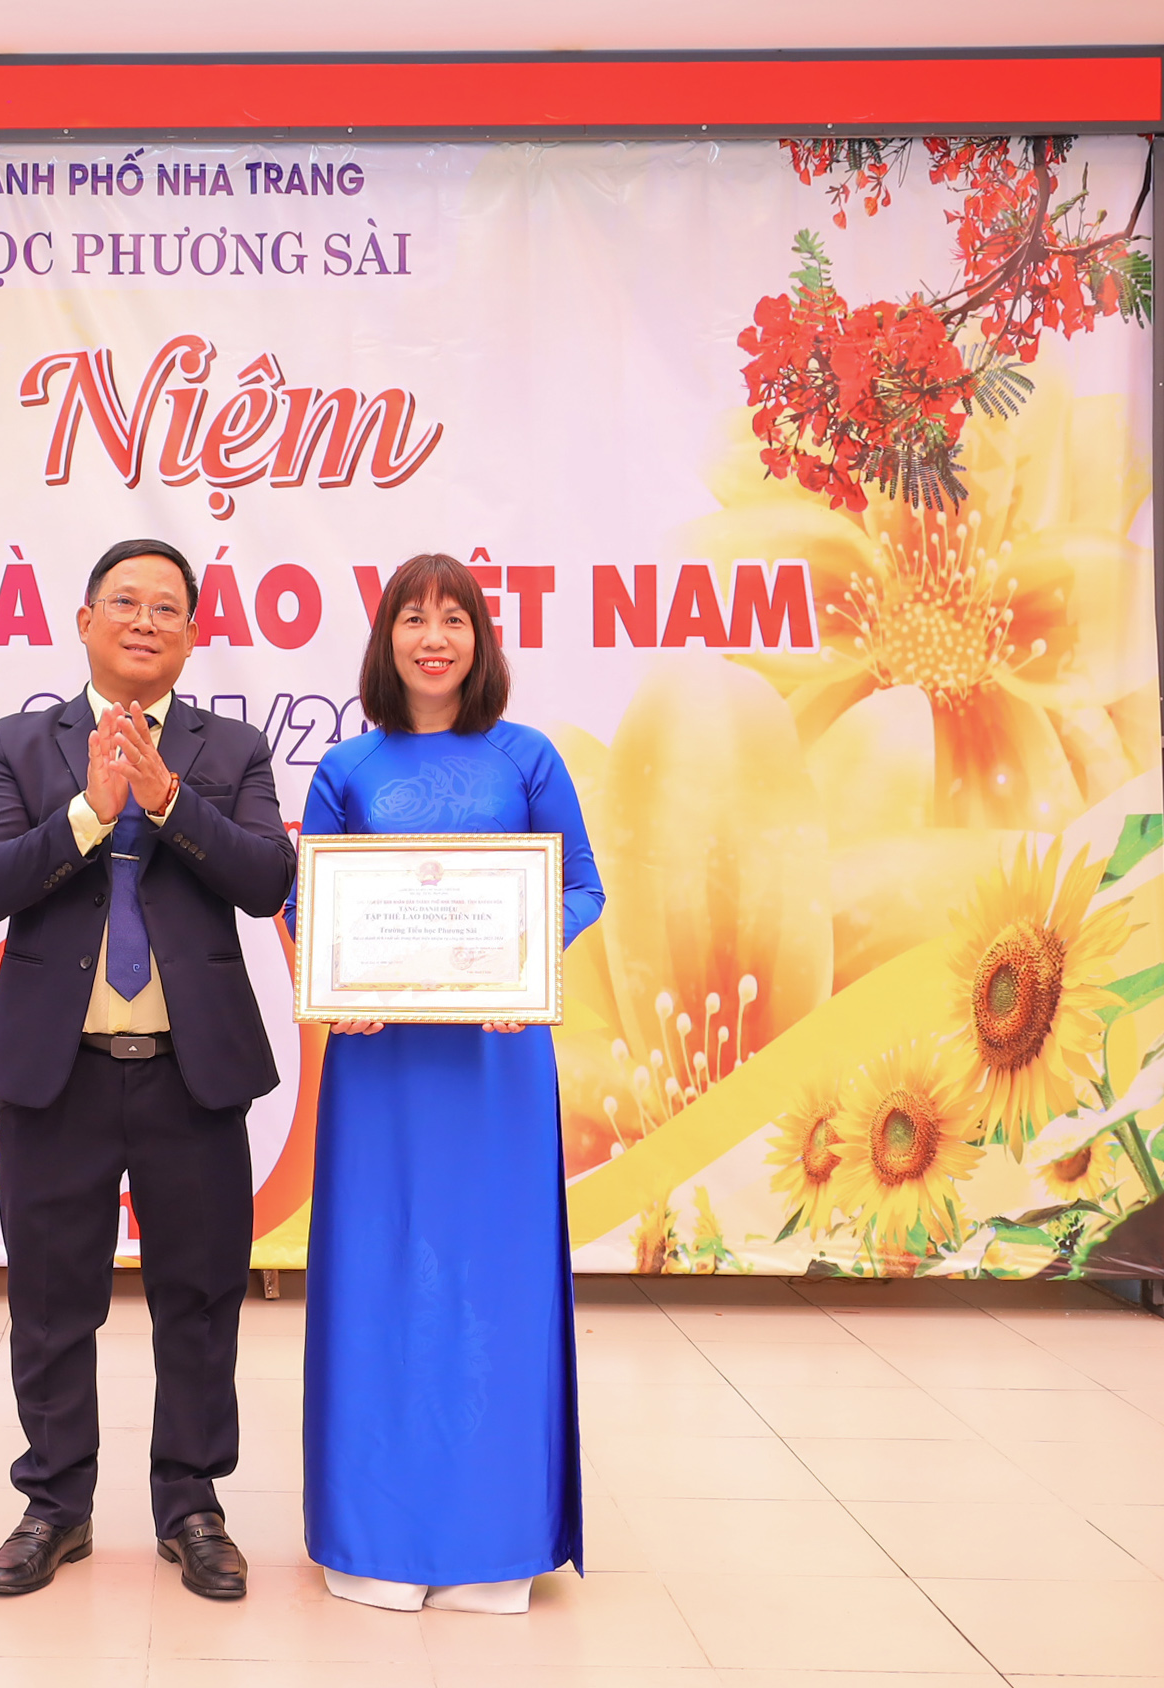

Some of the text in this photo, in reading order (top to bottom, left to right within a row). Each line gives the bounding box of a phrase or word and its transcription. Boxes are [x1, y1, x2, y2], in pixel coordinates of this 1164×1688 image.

[69, 147, 146, 196] PHỐ
[157, 162, 234, 196] NHA
[245, 162, 365, 197] TRANG
[72, 226, 309, 276] PHƯƠNG
[324, 217, 412, 276] SÀI
[20, 333, 445, 519] Niệm
[593, 564, 814, 648] NAM
